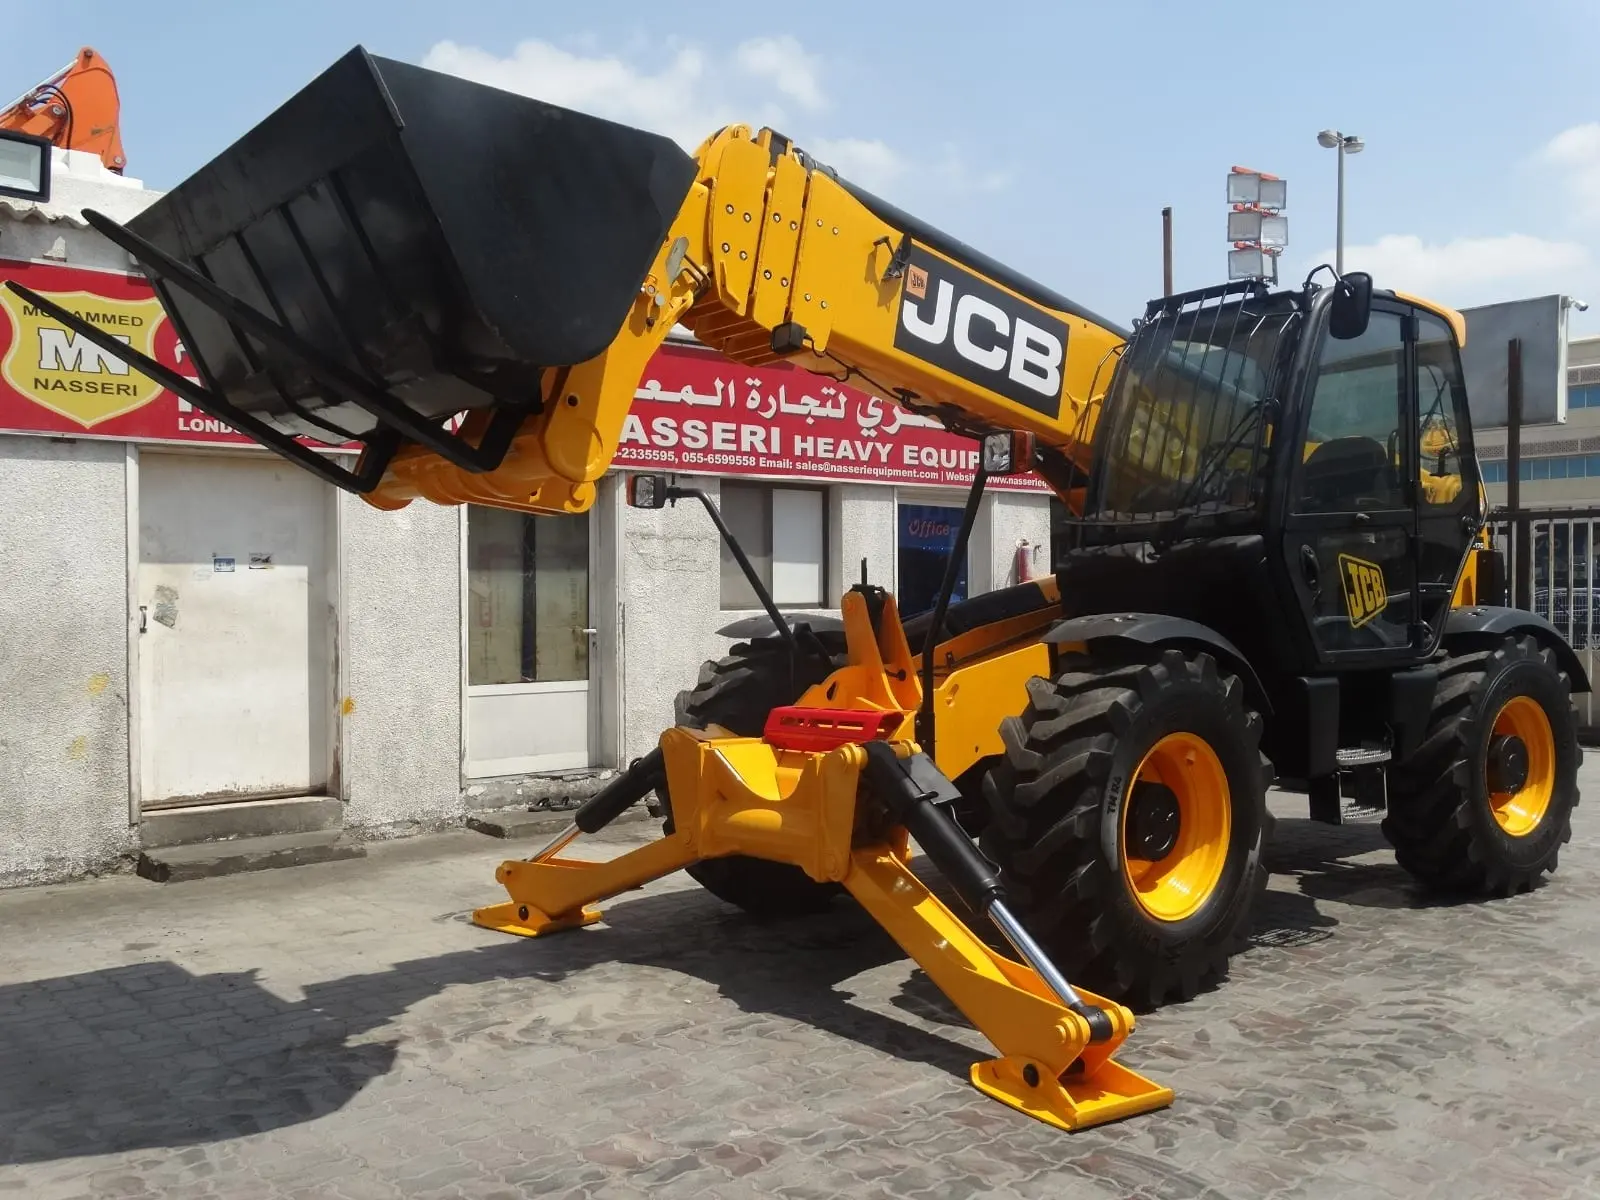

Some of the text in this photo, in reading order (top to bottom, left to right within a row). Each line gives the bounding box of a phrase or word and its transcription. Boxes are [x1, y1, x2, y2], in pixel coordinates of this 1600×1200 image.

[23, 304, 143, 327] MAMMED
[902, 279, 1062, 397] JCB
[33, 377, 138, 397] NASSERI
[744, 376, 848, 425] لتجارة
[178, 418, 242, 435] LOND
[794, 434, 894, 463] HEAVY
[682, 451, 756, 467] 055-6599558
[759, 456, 793, 469] Email:
[795, 460, 939, 481] sales@nasseriequipment.com
[908, 518, 950, 538] Office
[1346, 562, 1385, 619] JCB
